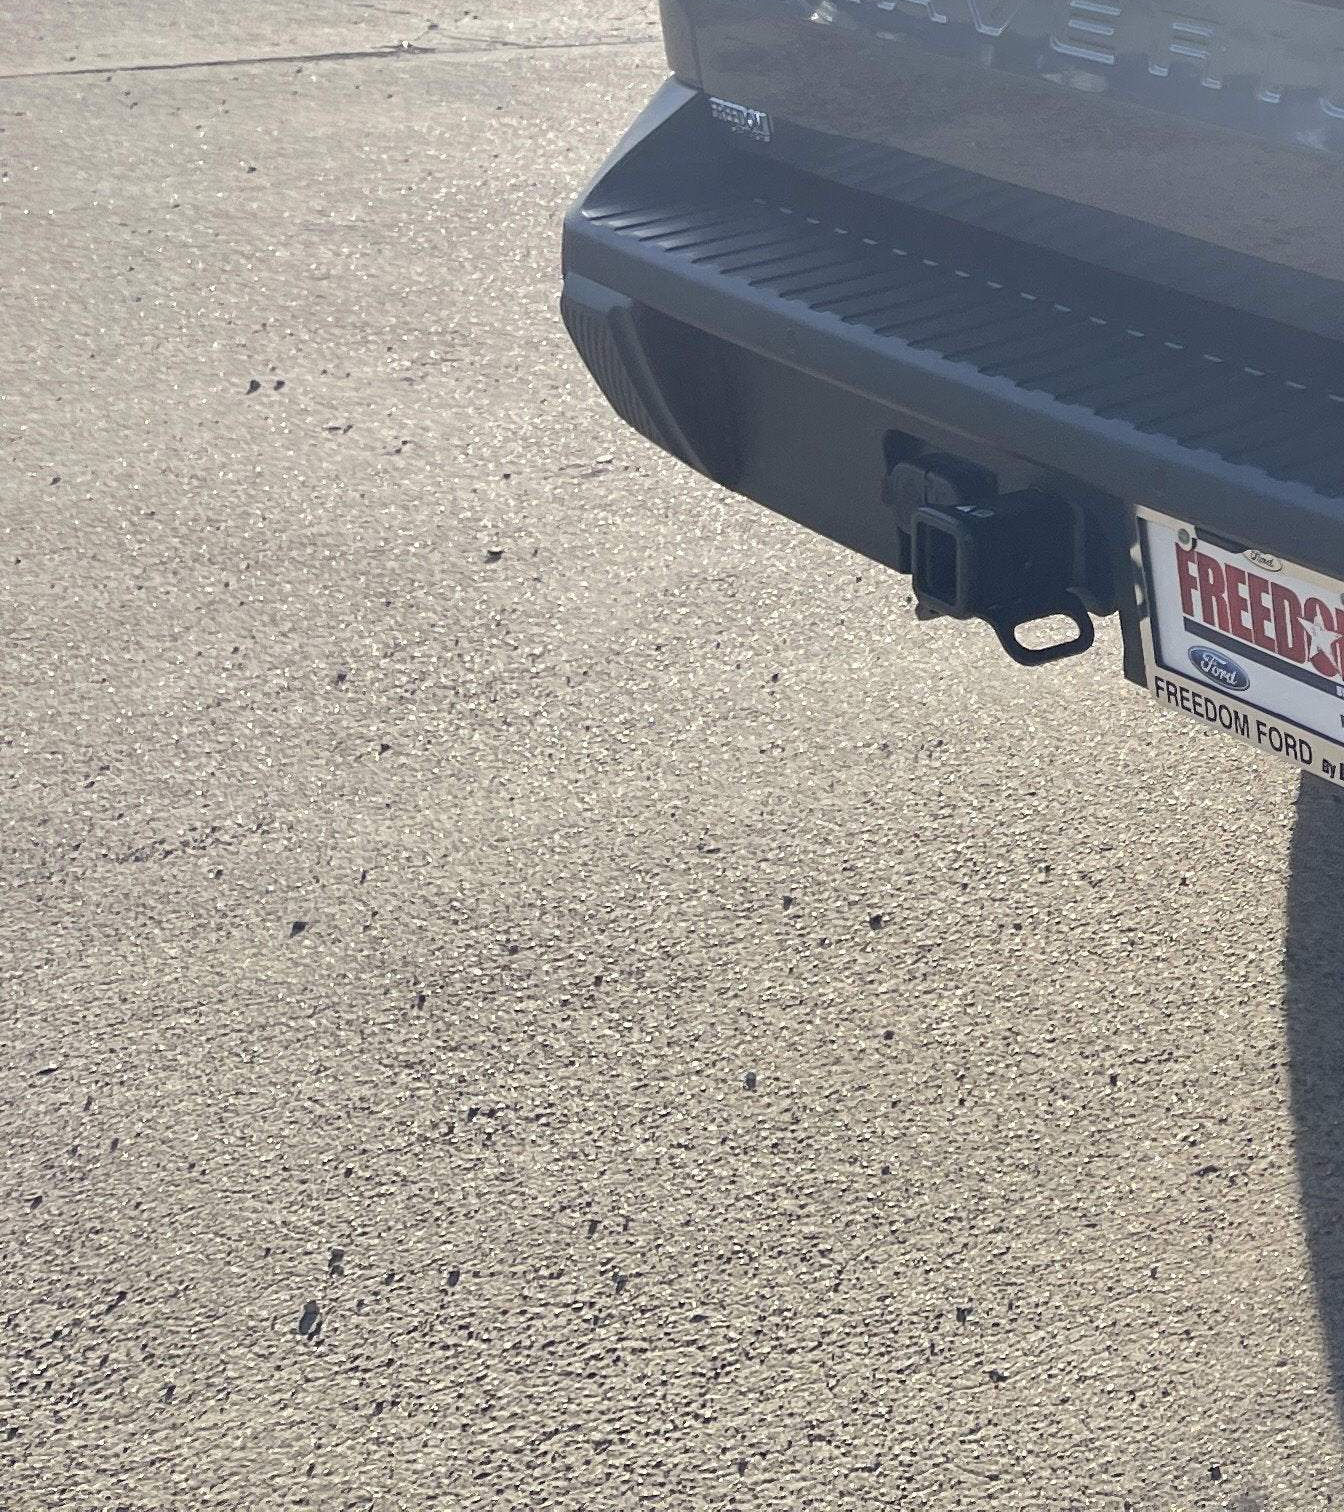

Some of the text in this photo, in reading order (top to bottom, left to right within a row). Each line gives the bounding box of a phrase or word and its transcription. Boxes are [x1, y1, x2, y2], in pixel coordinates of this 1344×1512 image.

[1200, 652, 1238, 686] Ford
[1154, 675, 1250, 739] FREEDOM
[1255, 719, 1313, 766] FORD
